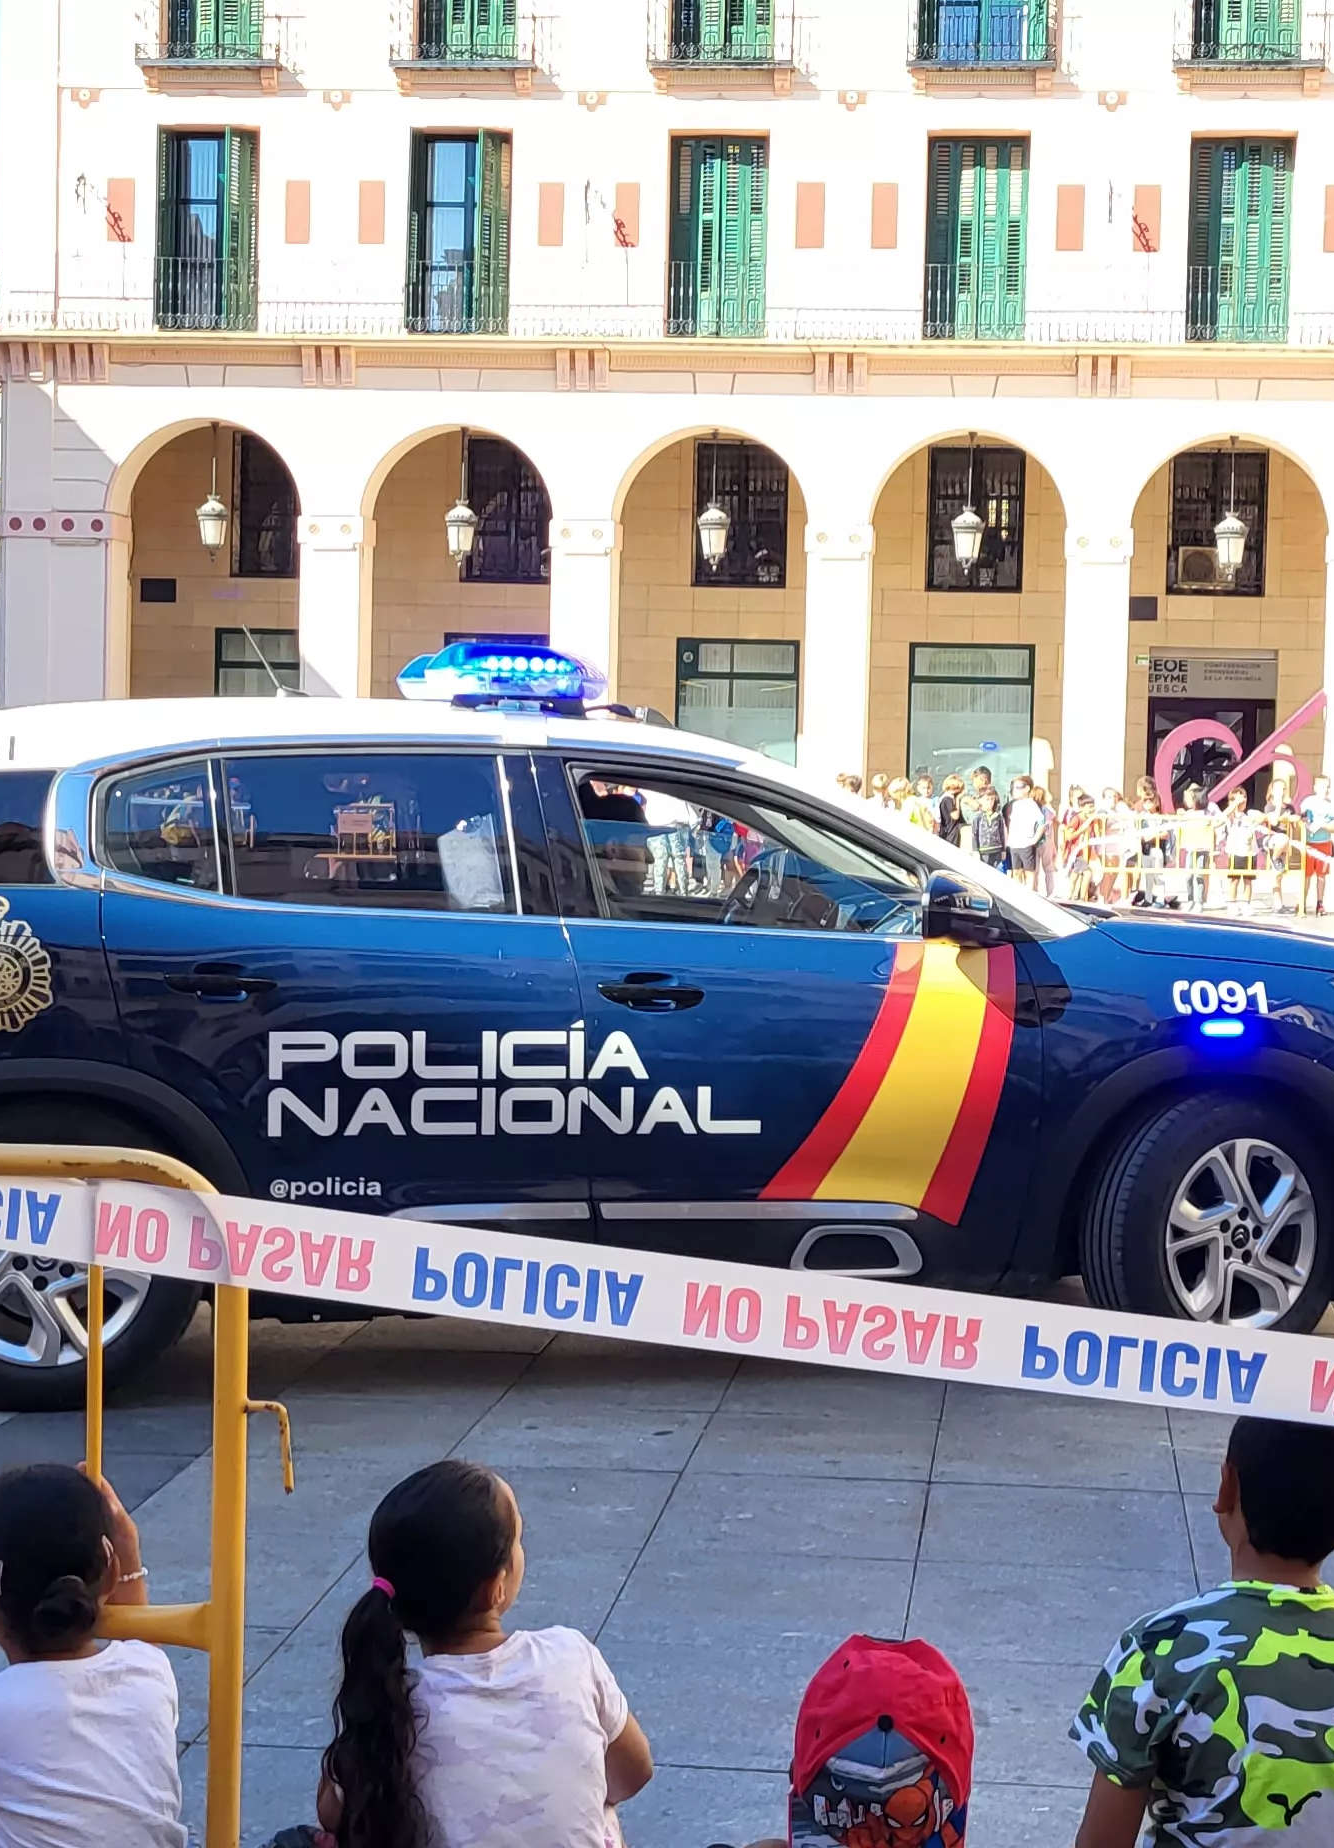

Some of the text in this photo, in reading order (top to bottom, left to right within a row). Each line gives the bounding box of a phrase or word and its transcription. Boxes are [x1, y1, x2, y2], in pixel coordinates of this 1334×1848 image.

[1148, 673, 1188, 683] EPYME
[267, 1019, 649, 1080] POLICÍA
[267, 1086, 762, 1137] NACIONAL
[270, 1177, 382, 1198] @policia
